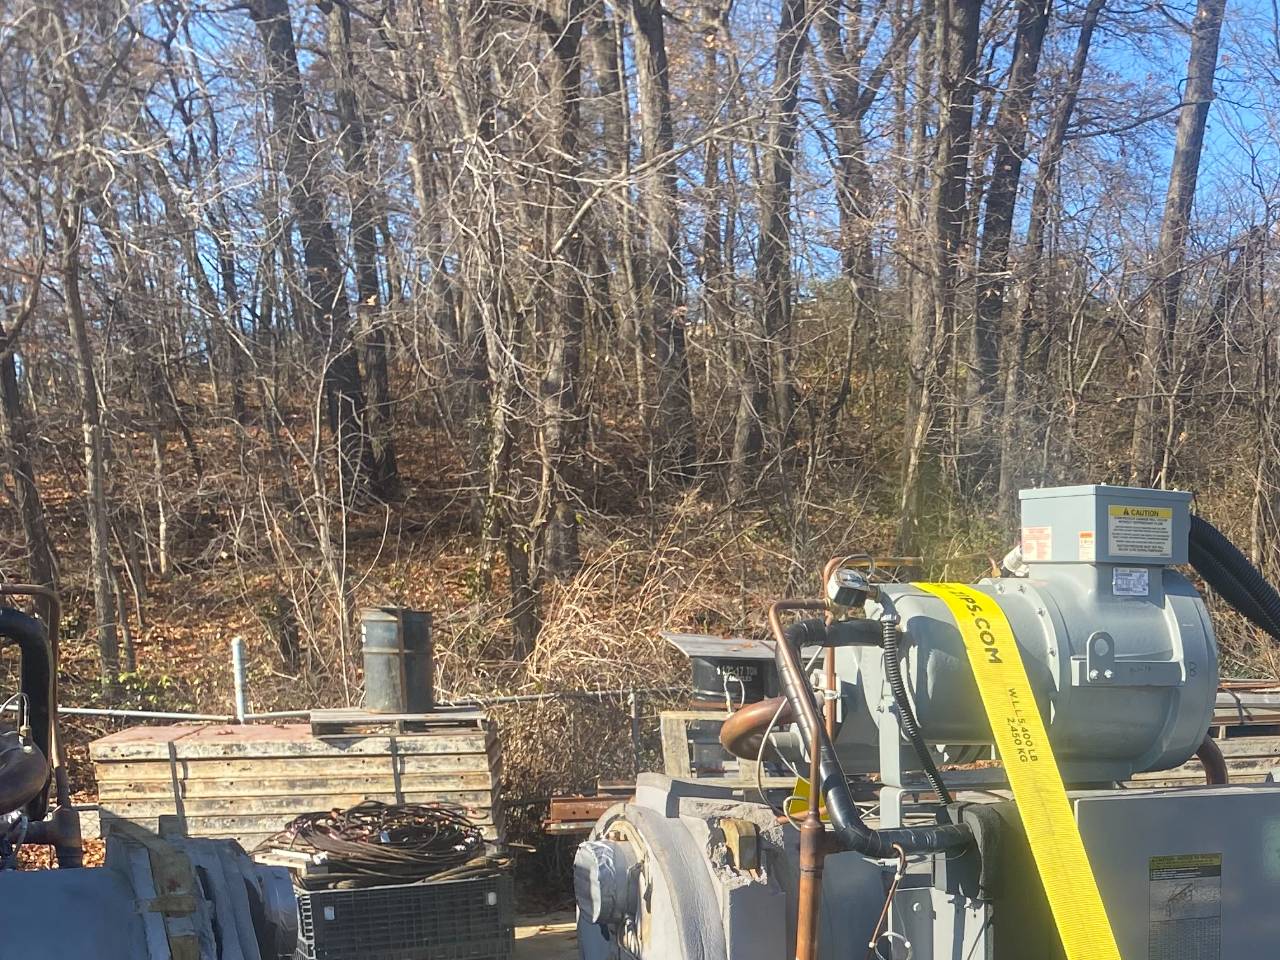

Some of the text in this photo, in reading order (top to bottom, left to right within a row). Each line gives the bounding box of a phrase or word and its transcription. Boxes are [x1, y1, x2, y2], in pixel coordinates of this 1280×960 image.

[1131, 508, 1159, 517] CAUTION
[1017, 748, 1028, 763] KG
[1028, 749, 1038, 762] LB
